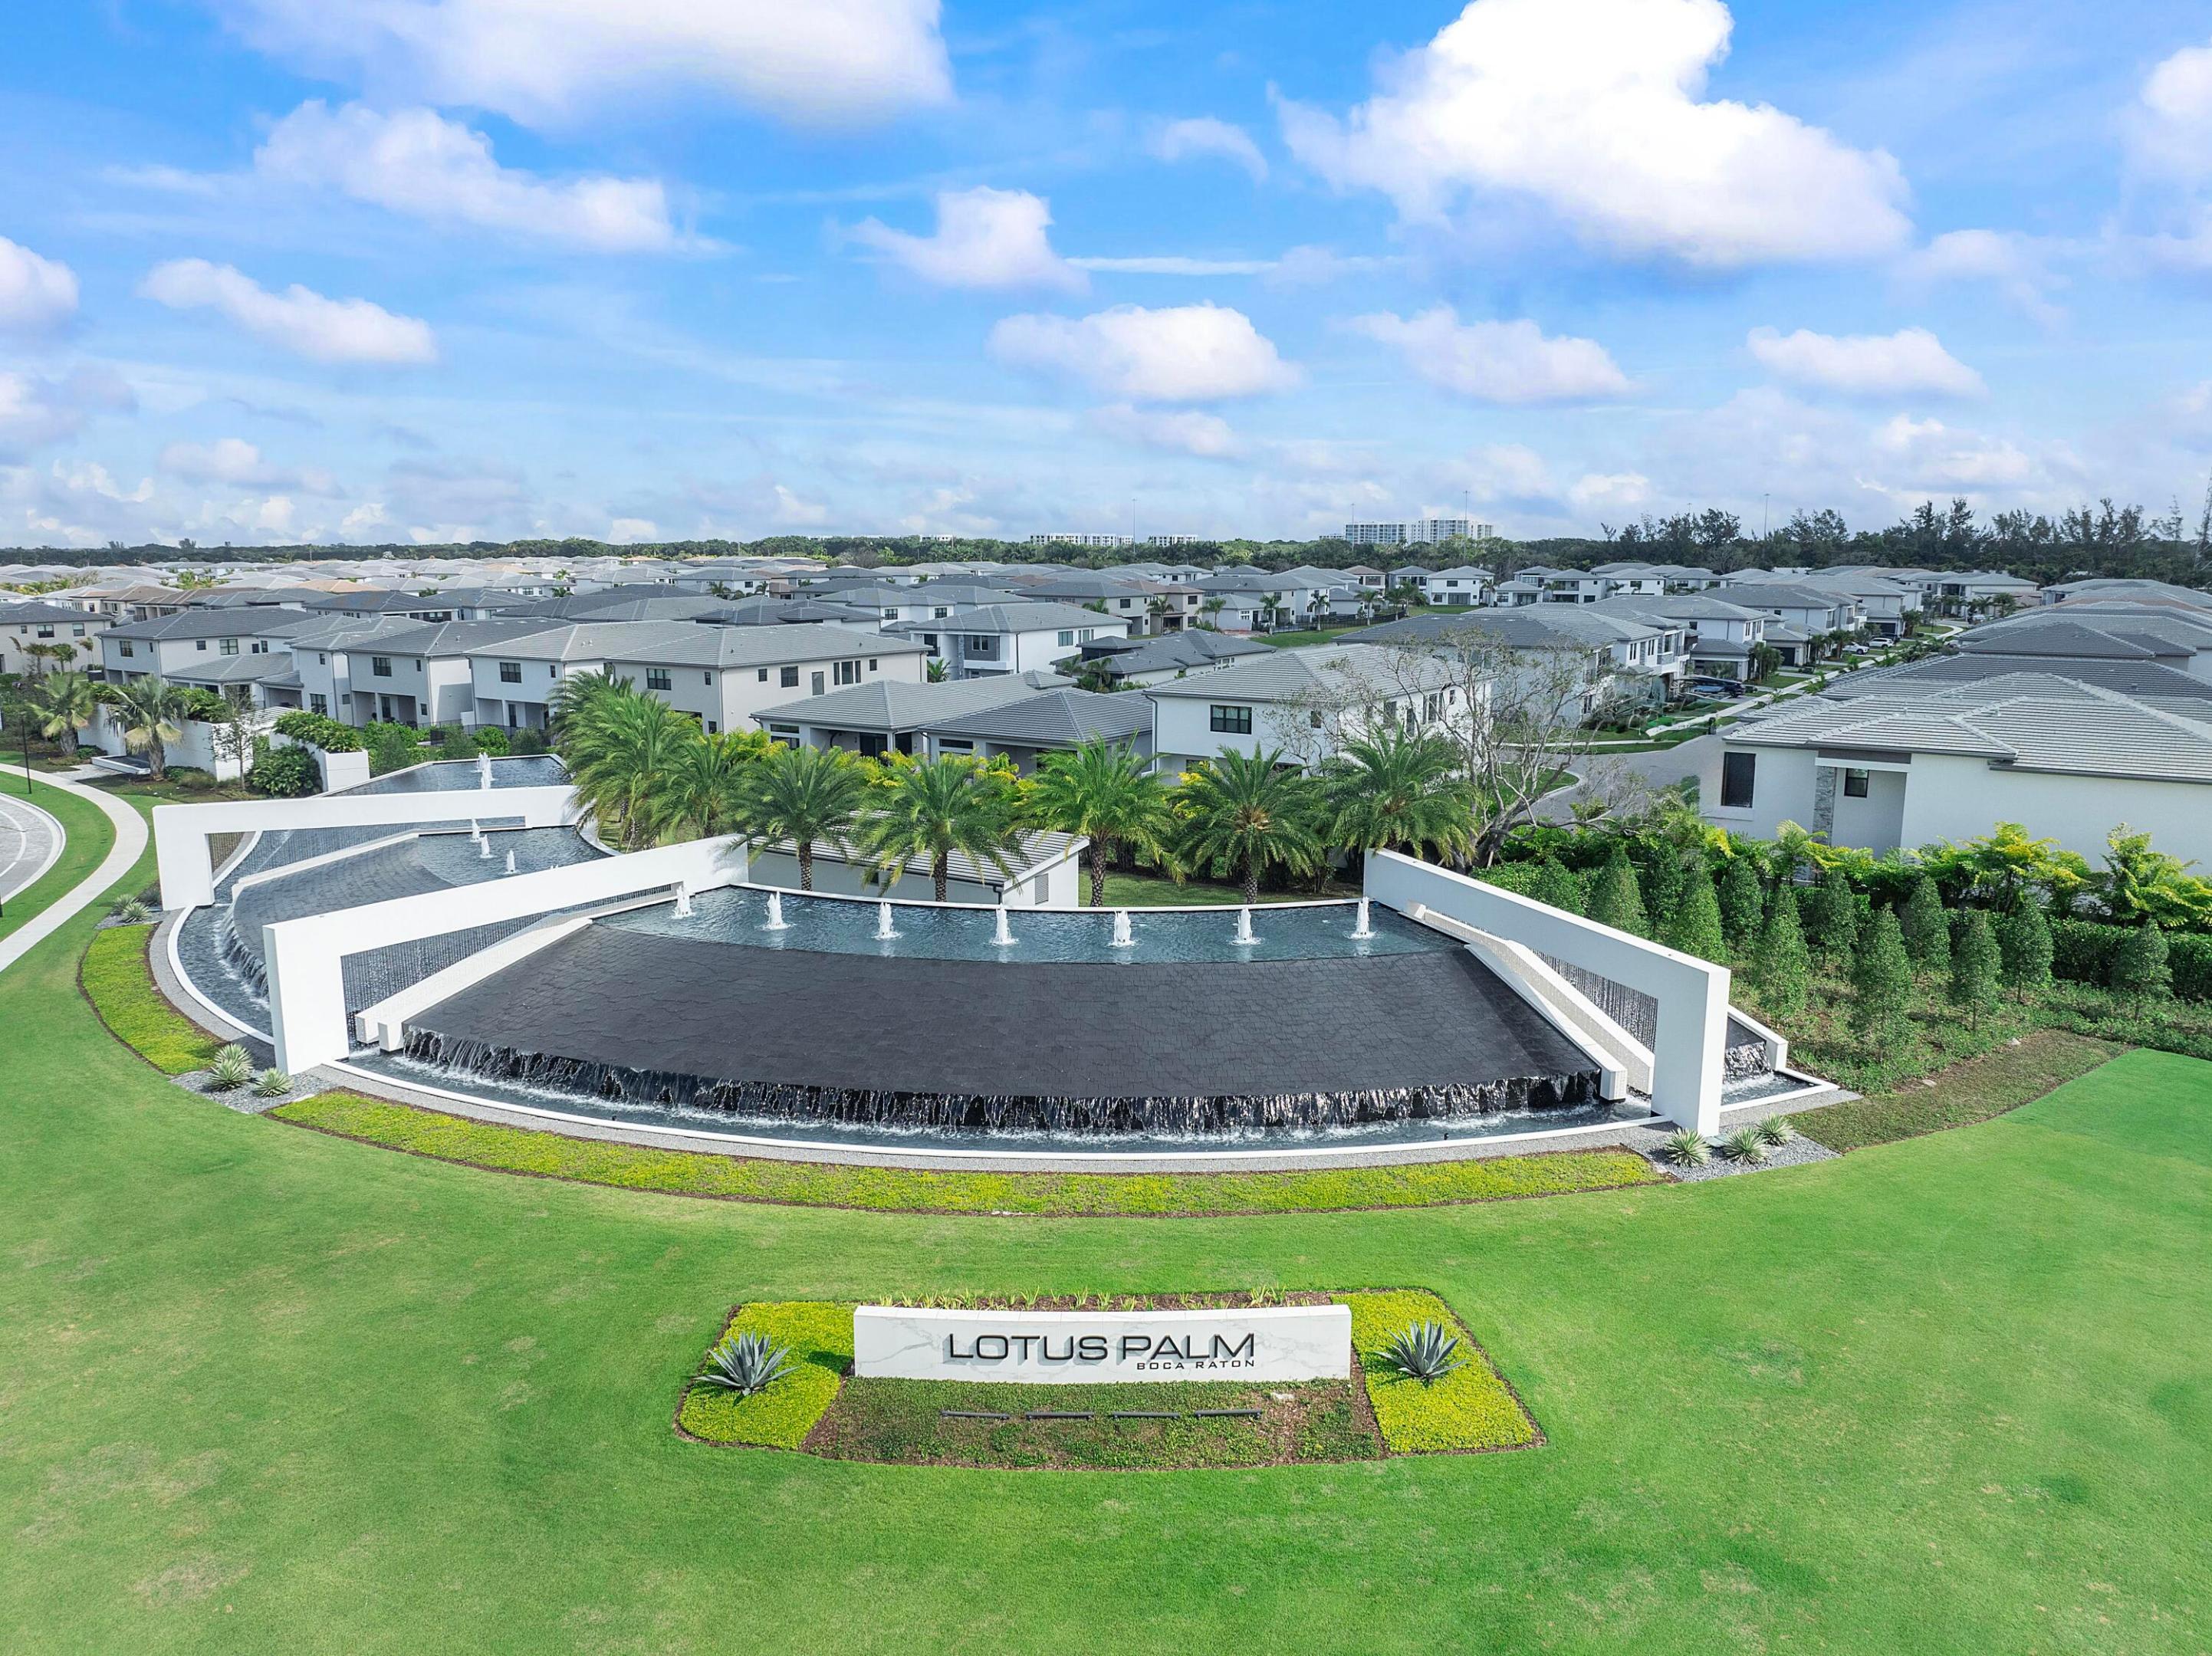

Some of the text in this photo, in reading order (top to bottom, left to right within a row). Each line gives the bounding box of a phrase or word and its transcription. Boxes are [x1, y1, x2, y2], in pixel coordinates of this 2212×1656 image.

[948, 1332, 1255, 1361] LOTUS PALM
[1137, 1360, 1255, 1370] BOCA RATON
